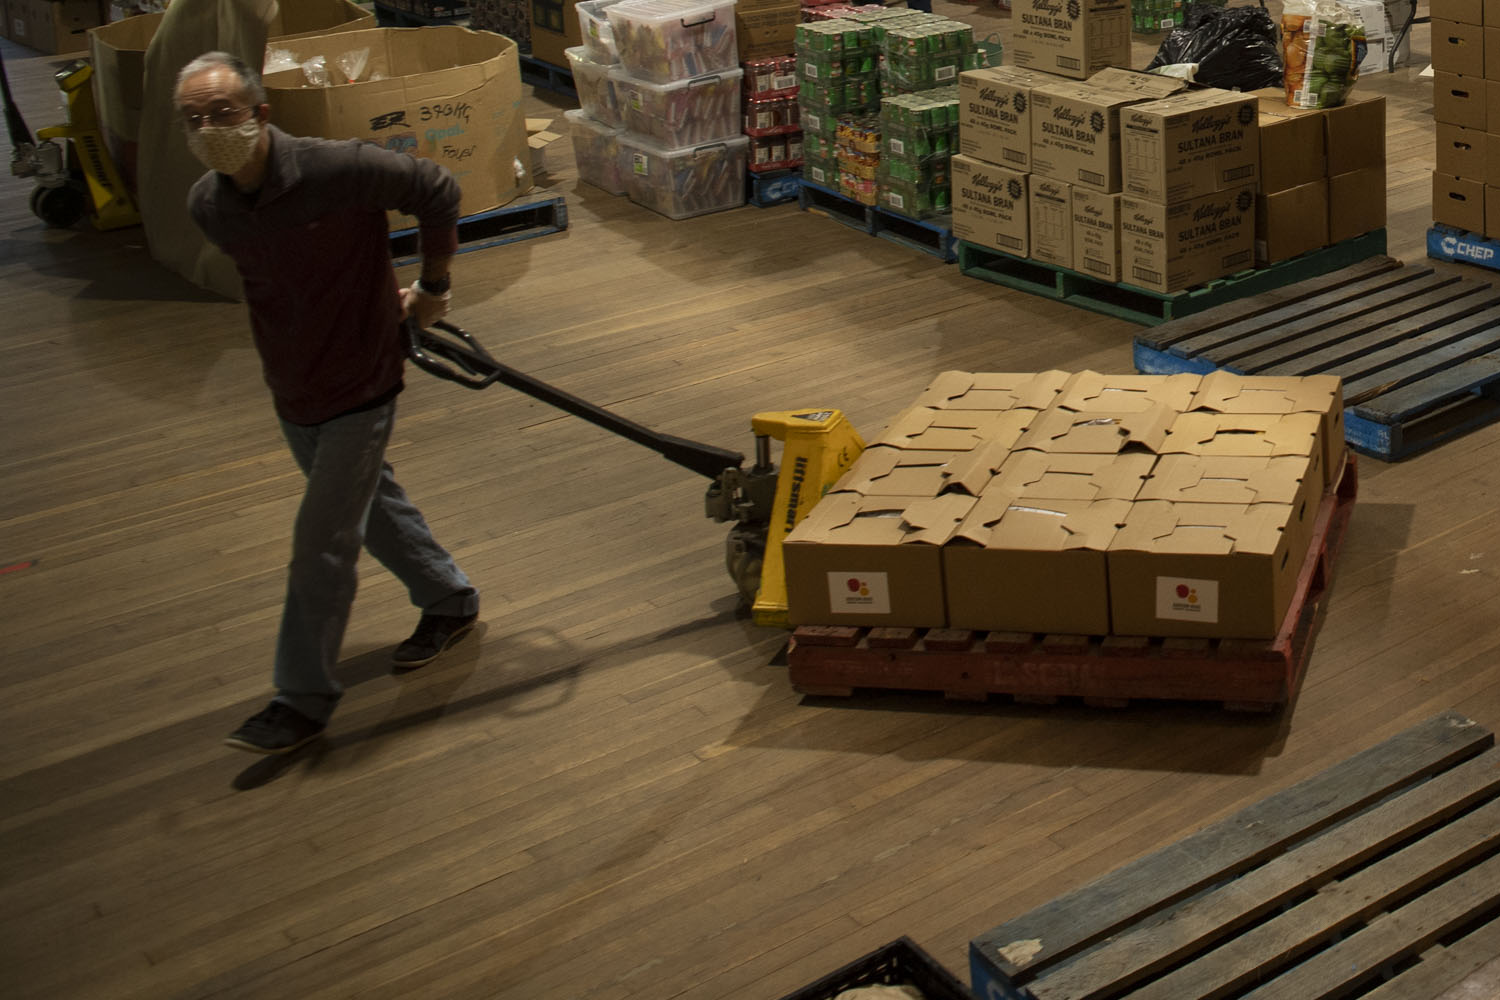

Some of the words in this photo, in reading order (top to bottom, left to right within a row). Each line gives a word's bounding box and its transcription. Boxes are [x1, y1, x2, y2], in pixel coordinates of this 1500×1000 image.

[1022, 13, 1052, 28] SULTANA
[1053, 19, 1073, 32] BRAN
[979, 86, 1010, 109] Kellogg's
[969, 102, 999, 119] SULTANA
[1000, 109, 1019, 124] BRAN
[1053, 104, 1088, 128] Kellogg's
[1191, 112, 1233, 134] Kellogg's
[1042, 121, 1074, 139] SULTANA
[1076, 129, 1096, 144] BRAN
[1177, 134, 1217, 153] SULTANA
[1219, 129, 1244, 144] BRAN
[972, 172, 1004, 195] Kellogg's
[961, 187, 991, 205] SULTANA
[993, 195, 1015, 211] BRAN
[1073, 213, 1098, 227] SULTANA
[1098, 220, 1114, 231] BRAN
[1192, 200, 1233, 223] Kellogg's
[1122, 221, 1148, 235] SULTANA
[1148, 227, 1165, 240] BRAN
[1178, 222, 1218, 243] SULTANA
[1219, 215, 1243, 232] BRAN
[1456, 240, 1495, 260] CHEP
